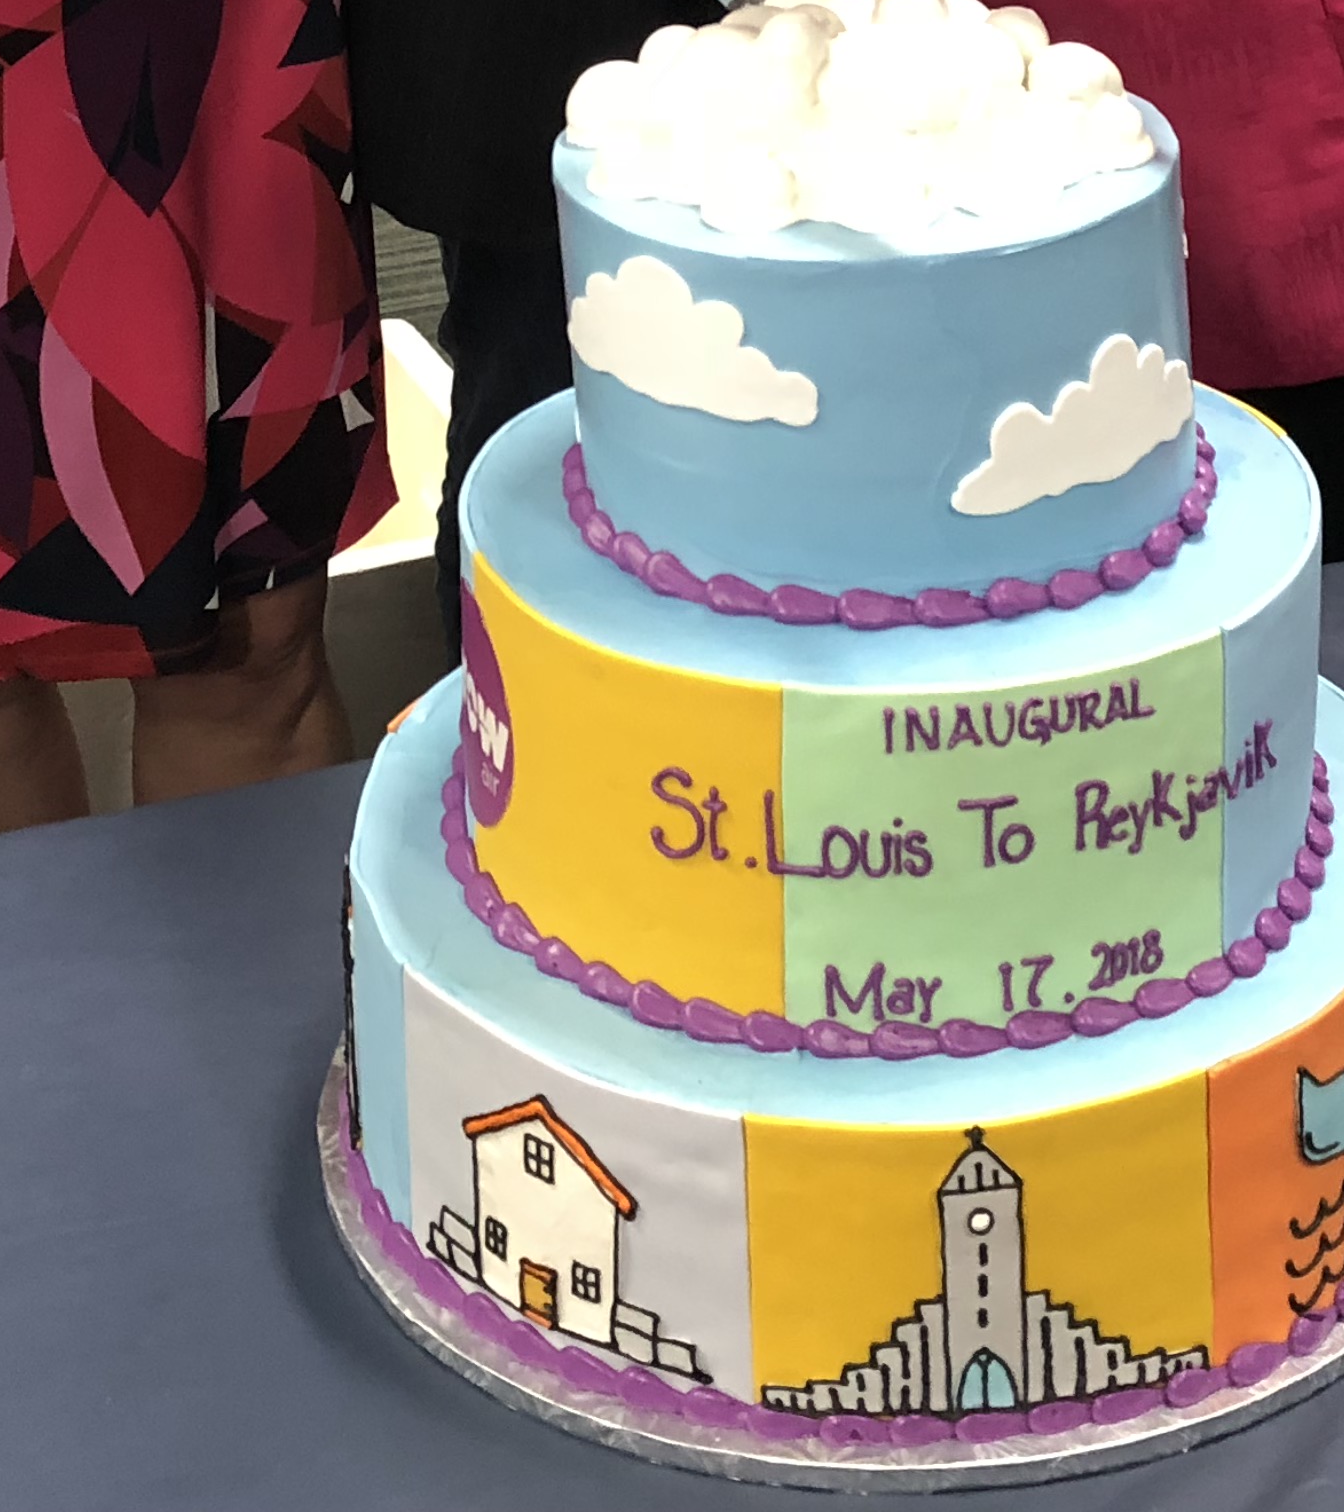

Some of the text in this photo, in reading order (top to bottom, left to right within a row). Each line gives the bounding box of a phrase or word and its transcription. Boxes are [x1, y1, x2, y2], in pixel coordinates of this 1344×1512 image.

[463, 668, 509, 773] OW
[882, 678, 1156, 755] INAUGURAL
[957, 794, 1035, 869] To
[824, 961, 943, 1023] May
[1088, 928, 1164, 990] 2018
